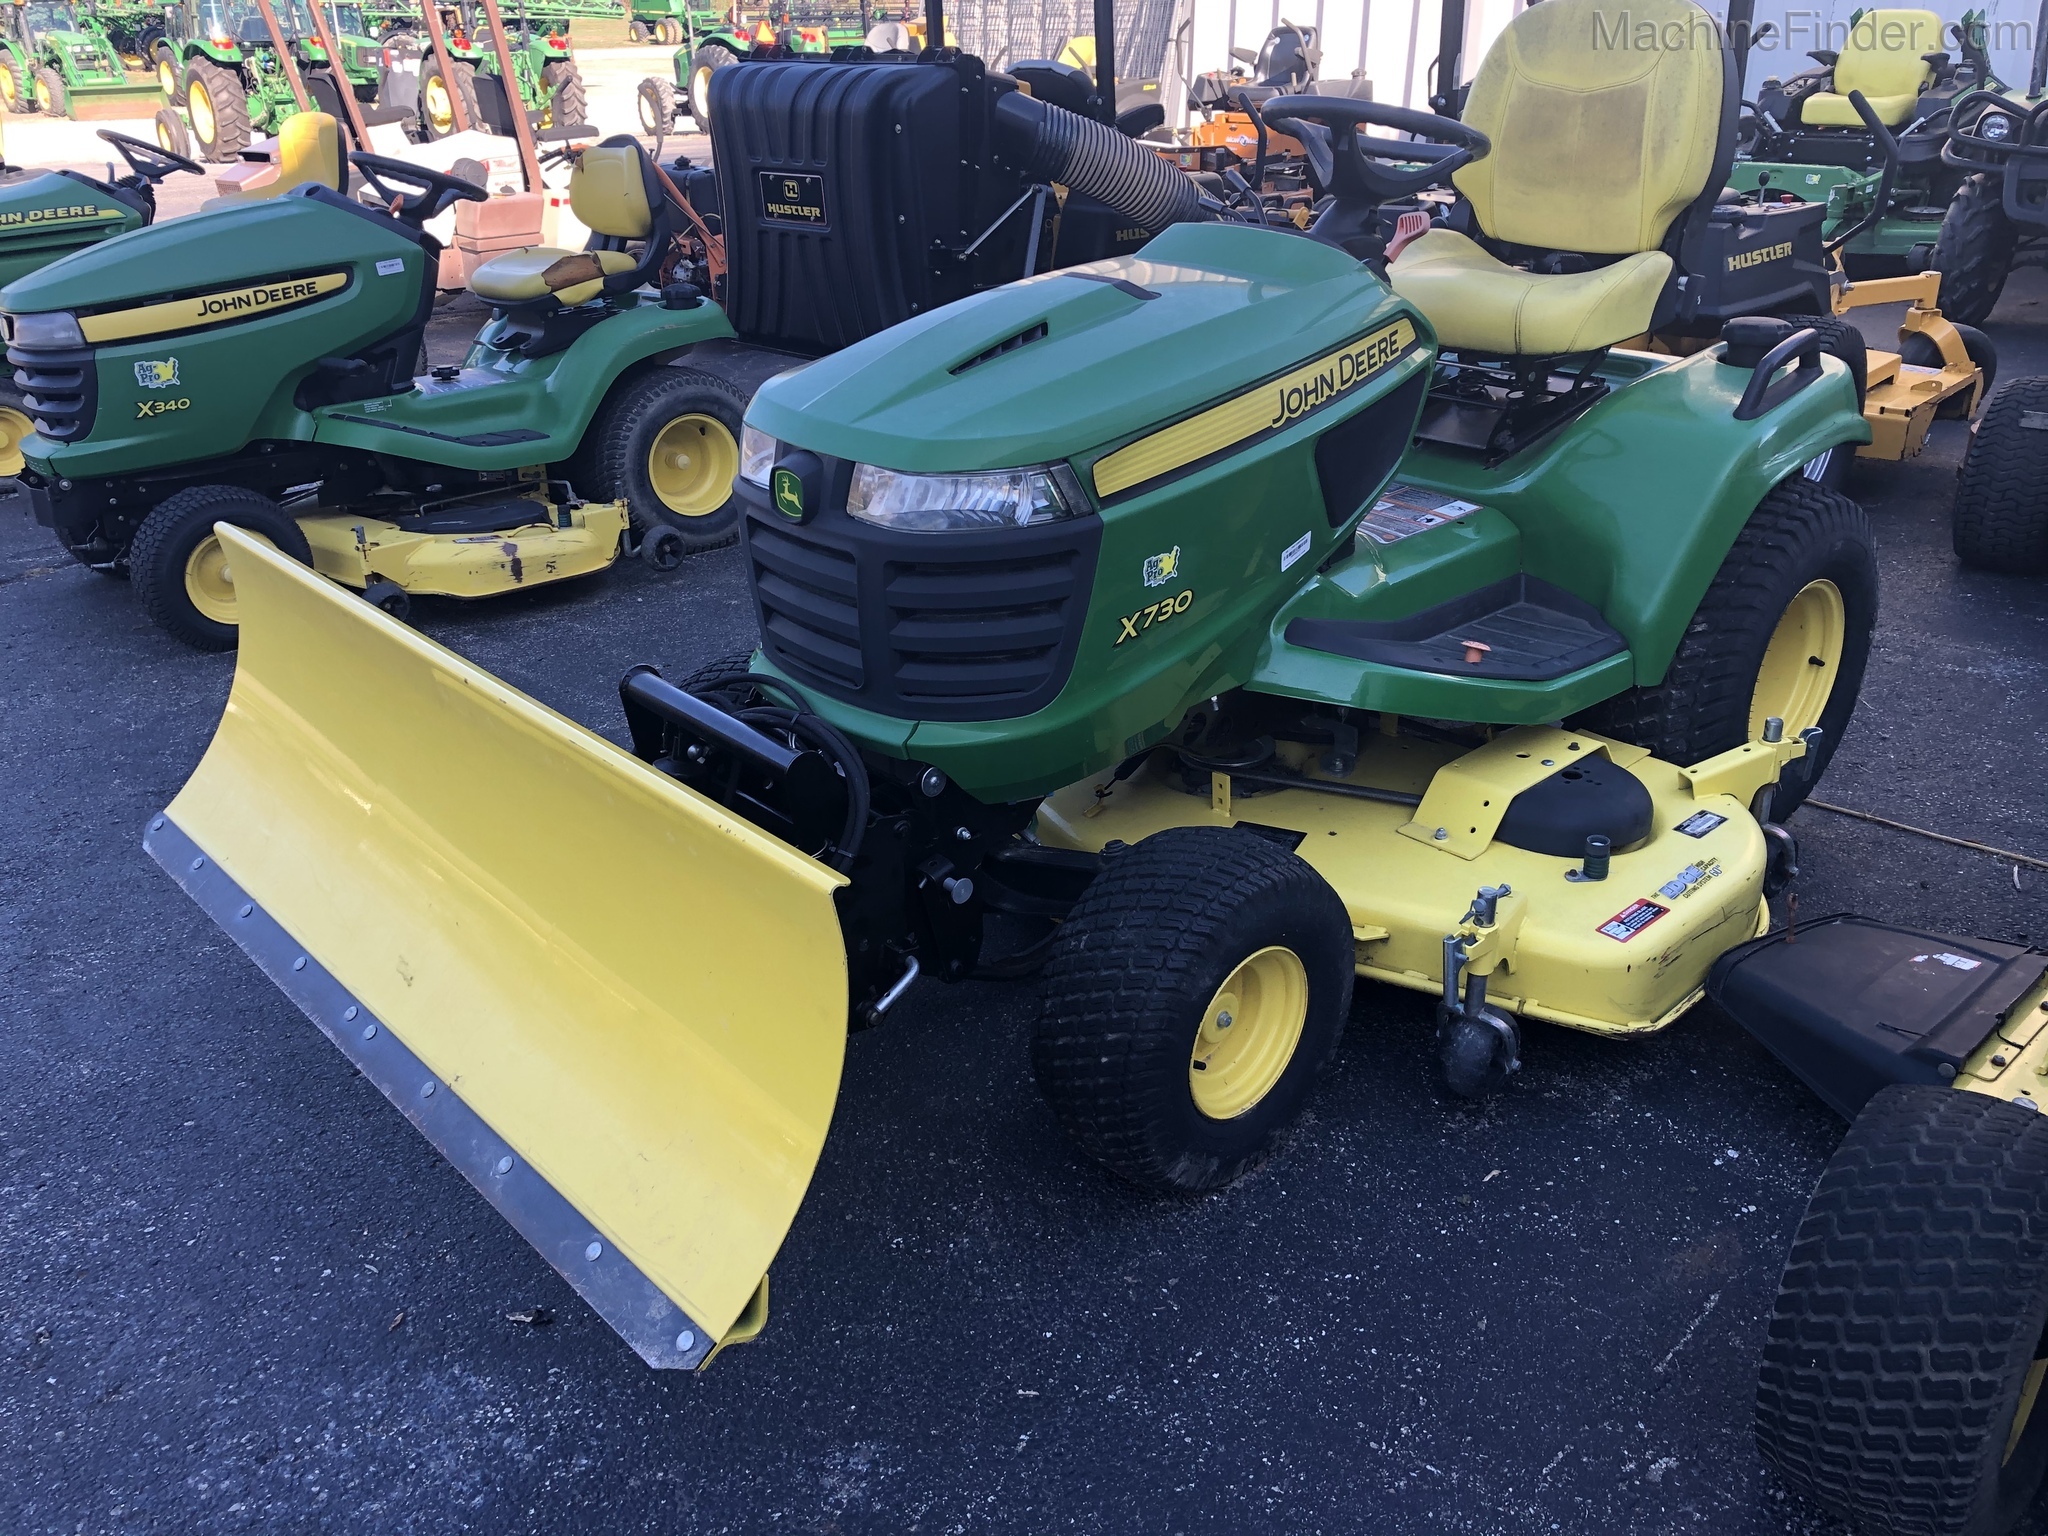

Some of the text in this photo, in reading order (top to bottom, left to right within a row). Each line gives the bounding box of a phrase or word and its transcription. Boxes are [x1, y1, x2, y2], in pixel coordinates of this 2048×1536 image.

[28, 204, 97, 221] DEERE
[767, 203, 821, 217] HUSTLER
[1727, 241, 1792, 272] HUSTLER
[197, 281, 318, 317] JOHN DEERE
[140, 373, 161, 383] Pro
[1271, 328, 1401, 427] JOHN DEERE
[135, 397, 191, 419] X340
[1147, 567, 1163, 583] Pro
[1114, 589, 1194, 646] X730
[1658, 864, 1706, 900] EDGE
